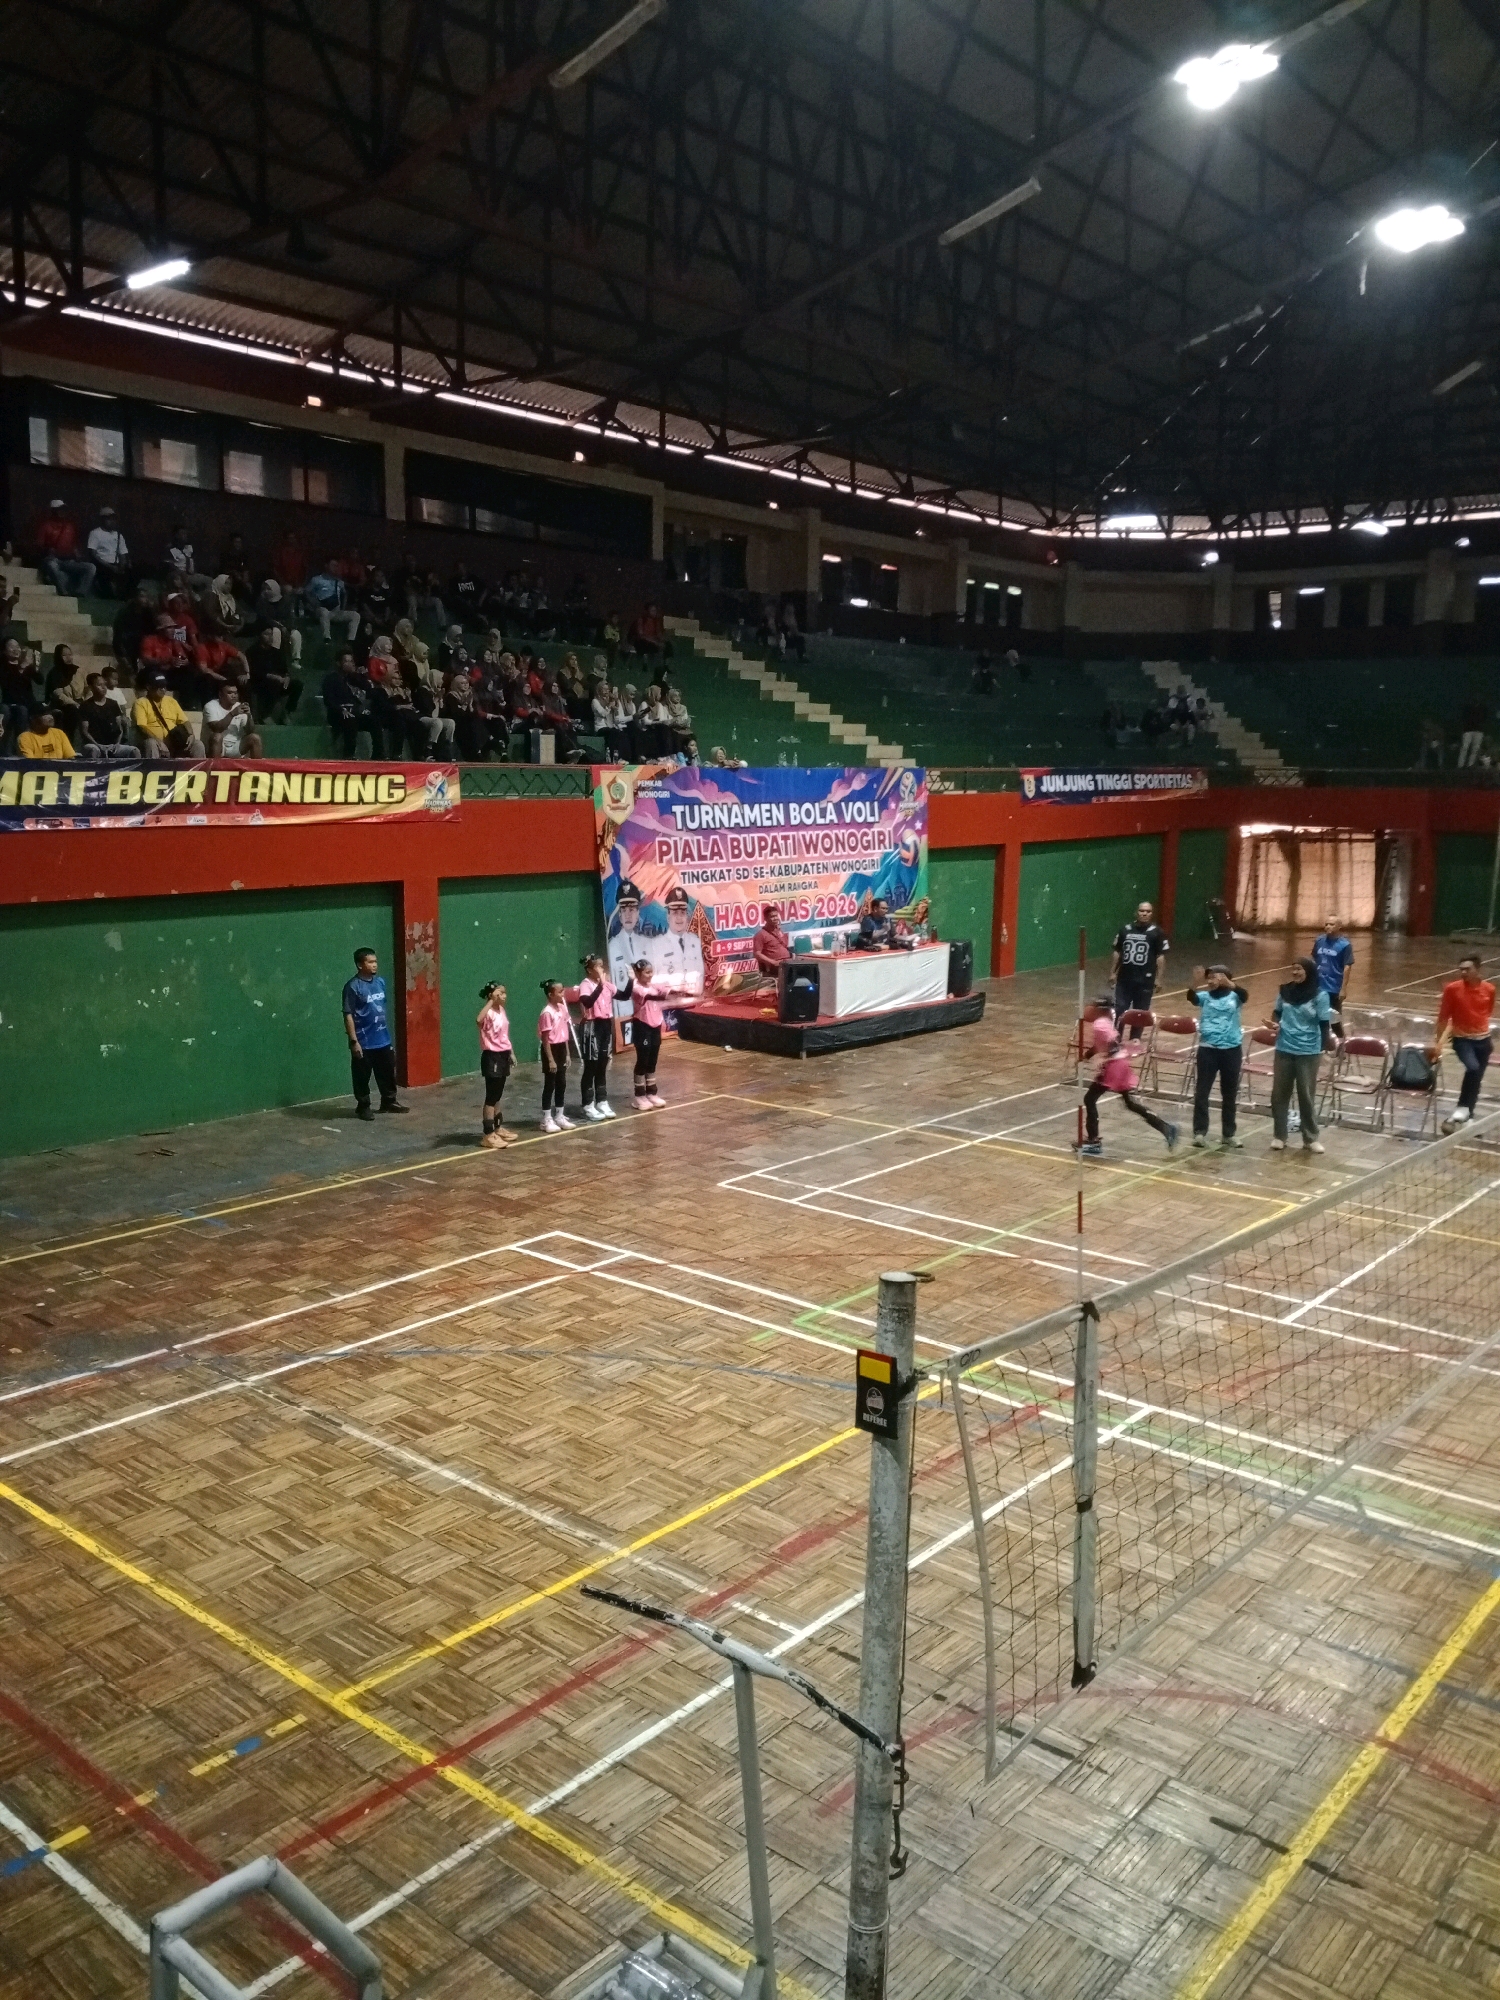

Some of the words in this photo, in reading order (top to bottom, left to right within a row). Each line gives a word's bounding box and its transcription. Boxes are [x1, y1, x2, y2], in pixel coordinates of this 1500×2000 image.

[106, 770, 406, 805] BERTANDING
[637, 790, 671, 798] WONOGIRI
[1040, 774, 1094, 793] JUNJUNG
[1095, 774, 1132, 790] TINGGI
[671, 803, 785, 830] TURNAMEN
[789, 801, 838, 826] BOLA
[841, 800, 880, 823] VOLI
[656, 836, 724, 865] PIALA
[729, 832, 798, 860] BUPATI
[802, 829, 893, 856] WONOGIRI
[680, 868, 732, 885] TINGKAT
[735, 866, 750, 881] SD
[753, 861, 829, 880] SE-KABUPATEN
[831, 857, 880, 873] WONOGIRI
[758, 883, 786, 895] DALAM
[814, 892, 858, 919] 2026
[727, 942, 732, 951] 9
